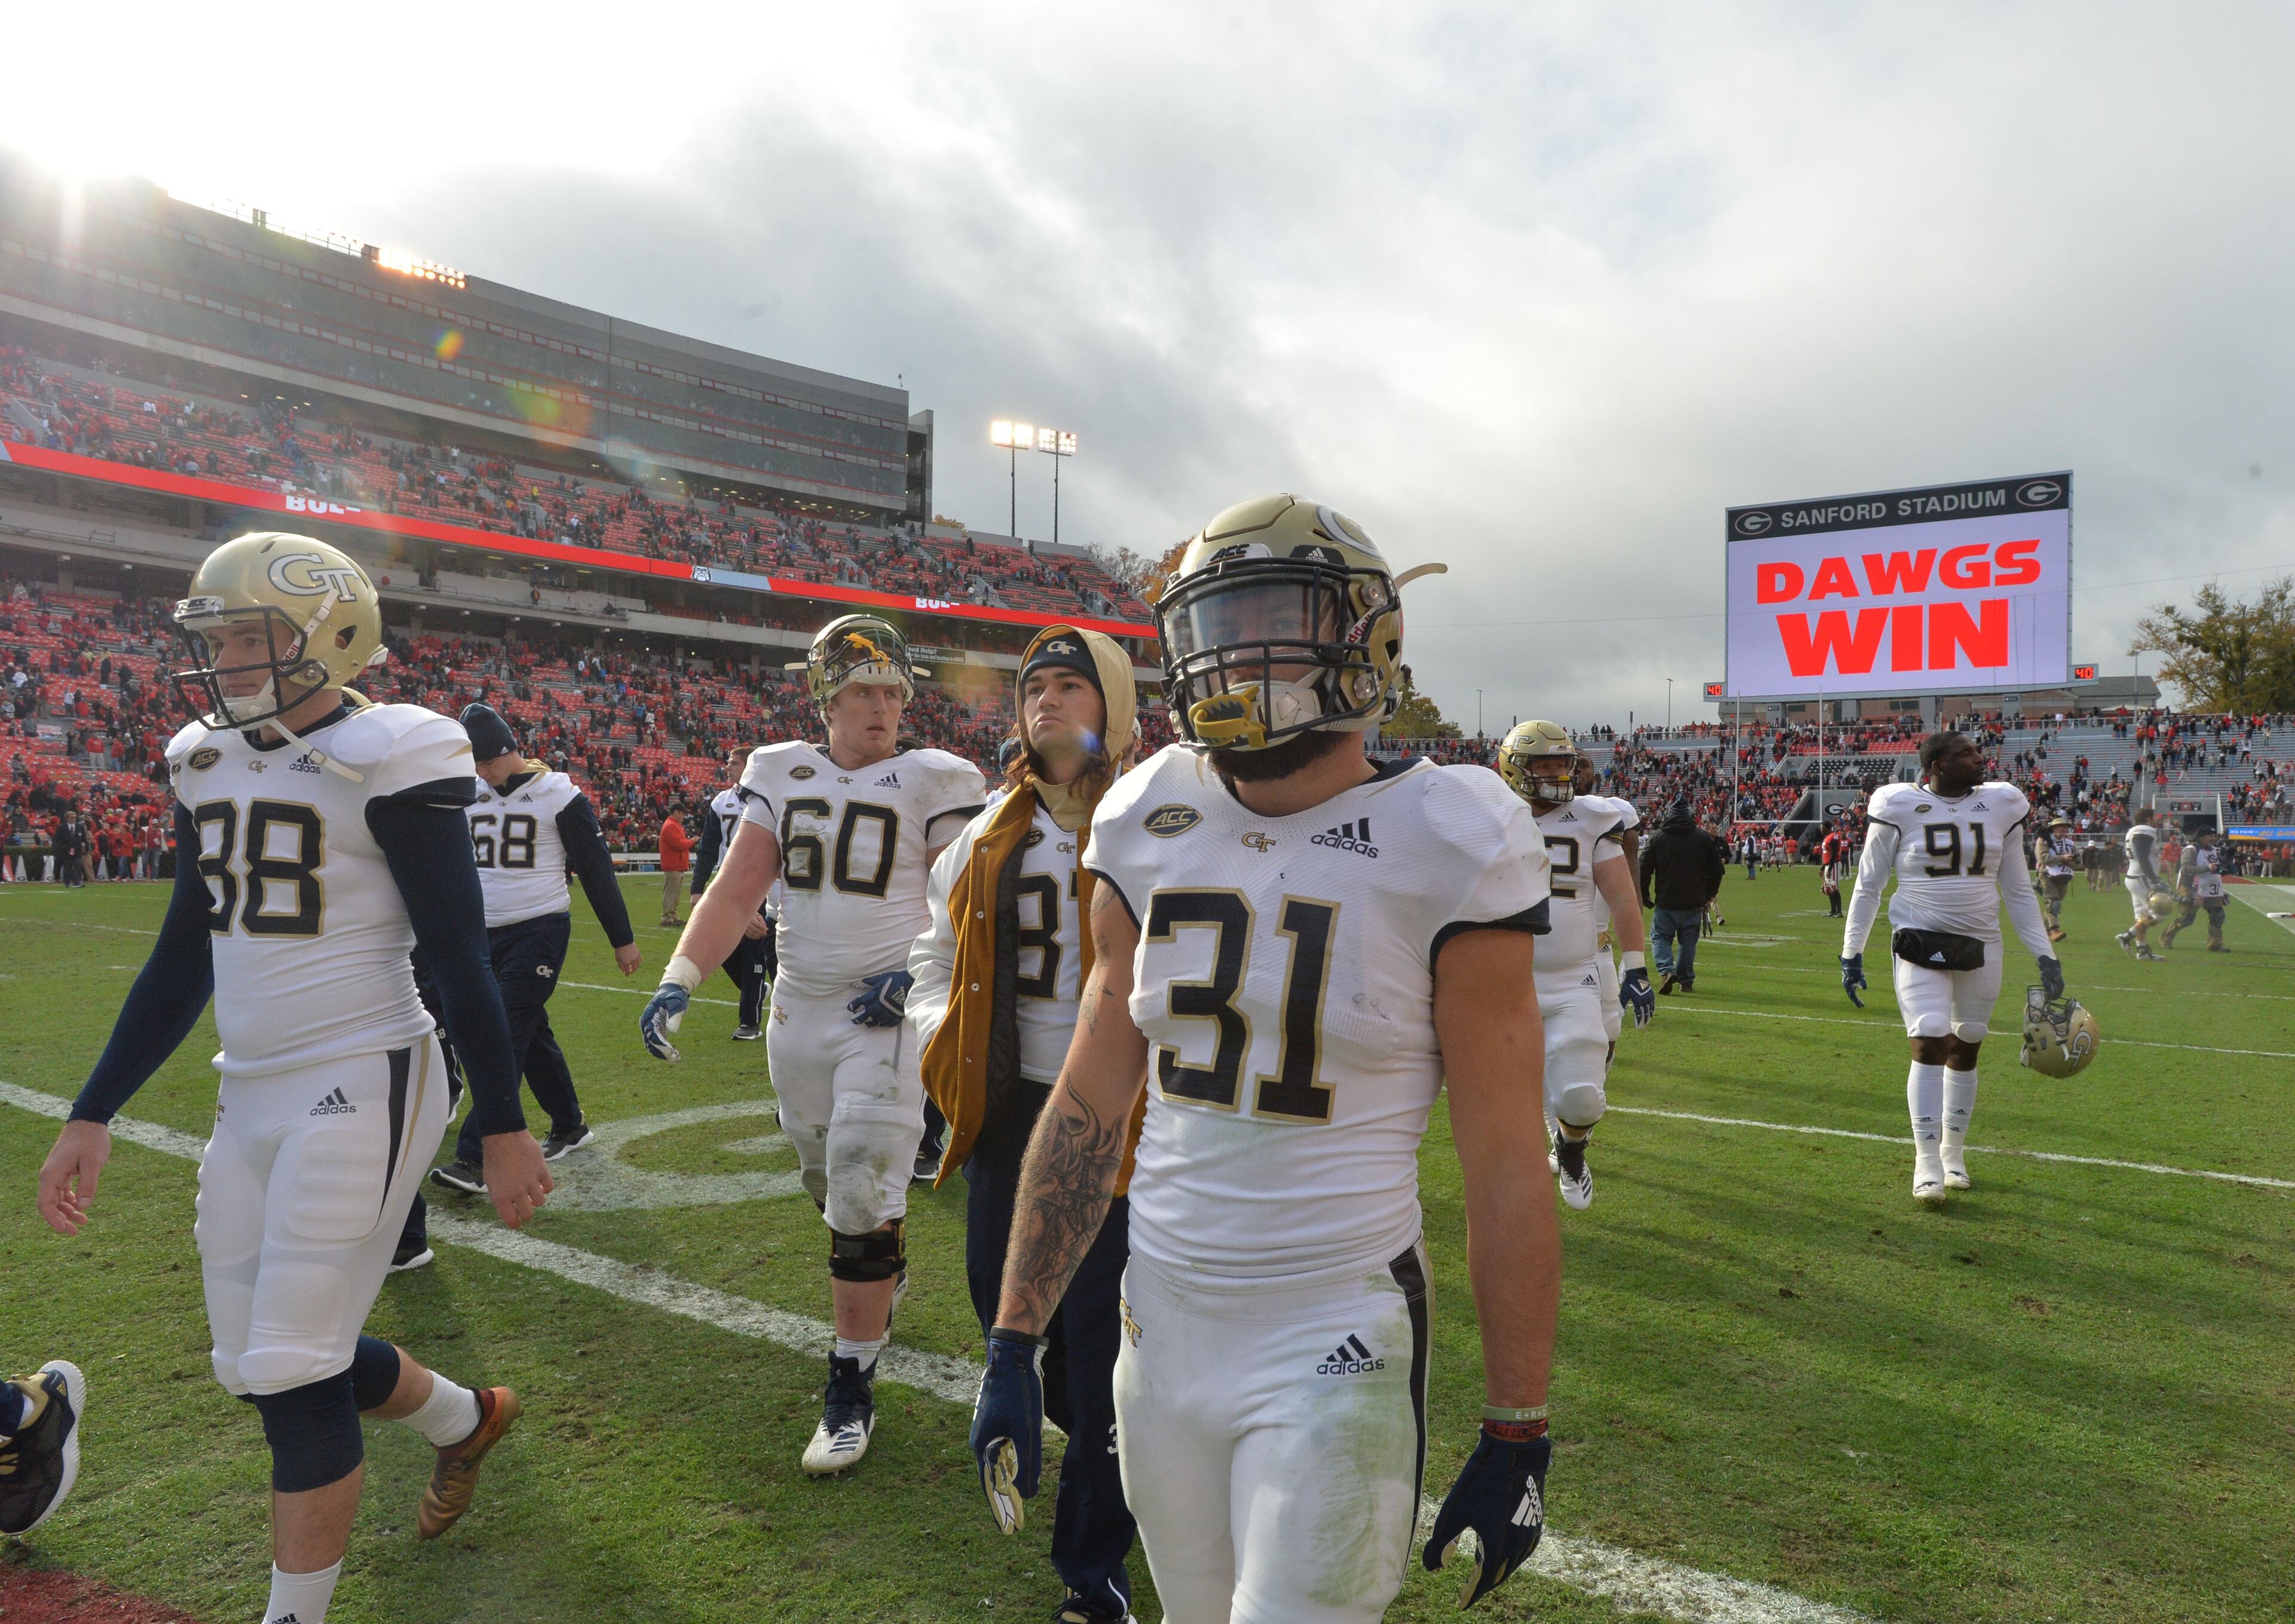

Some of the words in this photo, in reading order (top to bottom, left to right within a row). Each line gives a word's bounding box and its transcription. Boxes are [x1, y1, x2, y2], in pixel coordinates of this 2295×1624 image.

[1781, 502, 1887, 528] SANFORD
[1898, 489, 2006, 516] STADIUM
[1210, 544, 1249, 562] ACC
[1757, 539, 2042, 604] DAWGS
[1775, 599, 2009, 678] WIN
[1046, 641, 1077, 654] GT
[2076, 667, 2094, 679] 40
[1708, 685, 1721, 695] 40
[193, 751, 216, 765] ACC
[248, 760, 268, 774] GT
[289, 761, 321, 774] adidas
[873, 780, 901, 789] adidas
[1150, 810, 1194, 826] ACC
[469, 812, 539, 870] 68
[781, 796, 901, 900] 60
[1056, 841, 1076, 854] GT
[1241, 832, 1276, 853] GT
[1311, 834, 1379, 859] adidas
[1923, 821, 1987, 879] 91
[1145, 886, 1341, 1126] 31
[310, 1104, 357, 1116] adidas
[1317, 1358, 1385, 1375] adidas
